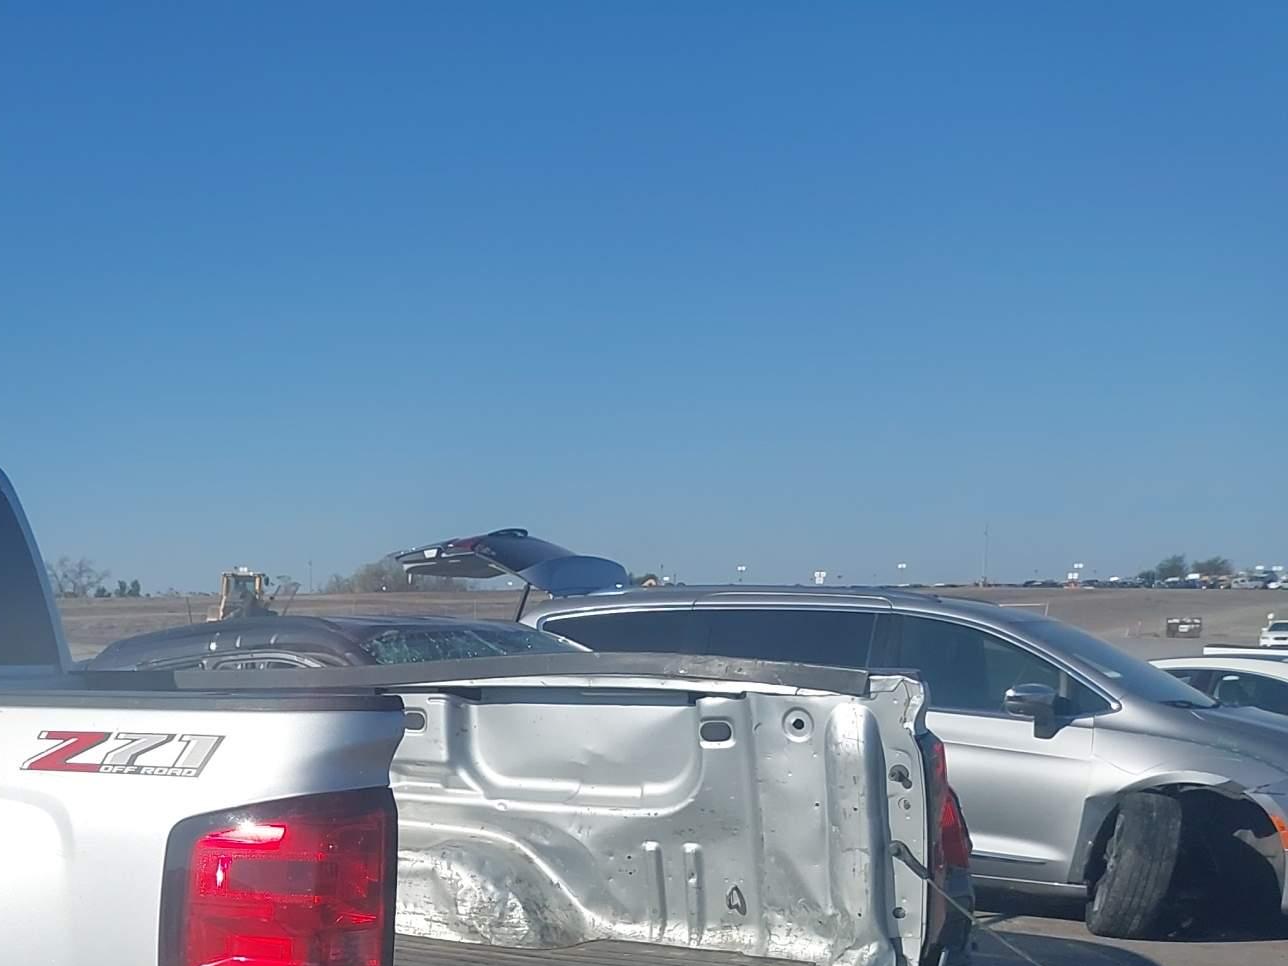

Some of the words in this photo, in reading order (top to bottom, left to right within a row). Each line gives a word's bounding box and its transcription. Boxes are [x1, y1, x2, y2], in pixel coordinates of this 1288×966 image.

[19, 730, 226, 775] Z71
[99, 764, 137, 776] OFF
[140, 766, 198, 777] ROAD
